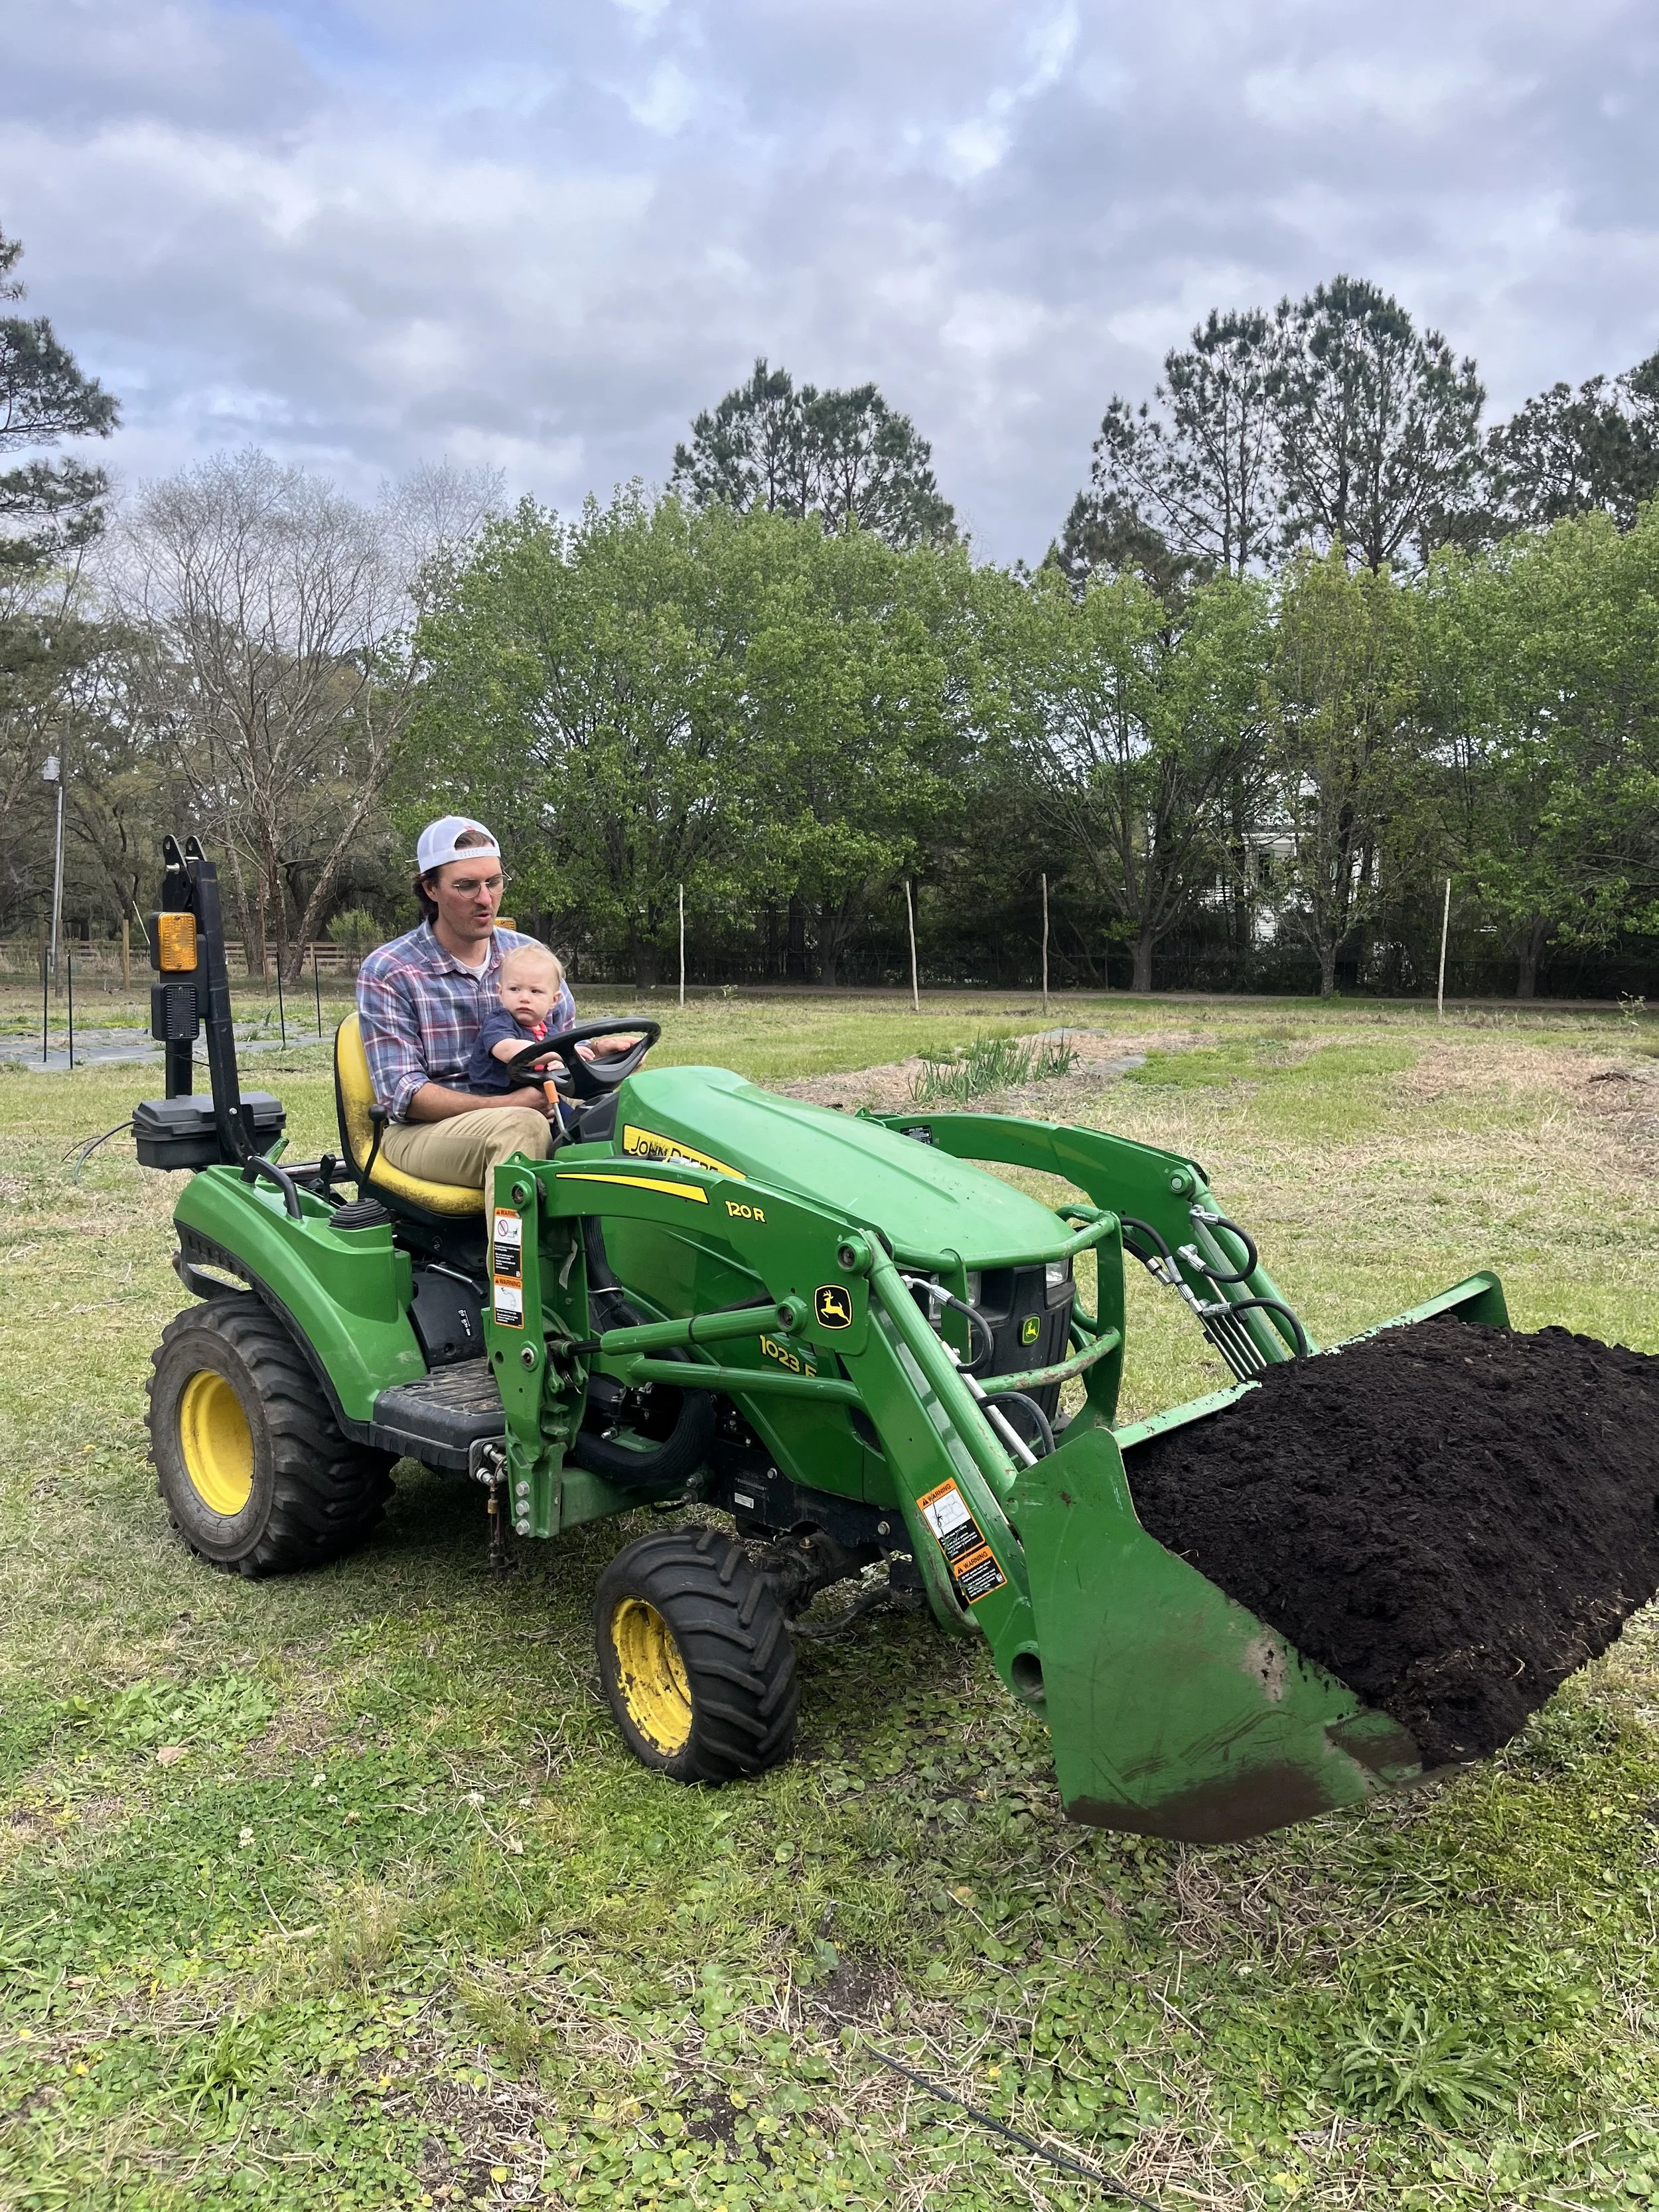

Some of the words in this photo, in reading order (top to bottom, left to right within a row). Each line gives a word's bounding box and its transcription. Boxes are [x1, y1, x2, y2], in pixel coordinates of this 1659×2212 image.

[499, 1278, 521, 1288] WARNING
[927, 1483, 952, 1503] WARNING
[963, 1551, 989, 1569] WARNING
